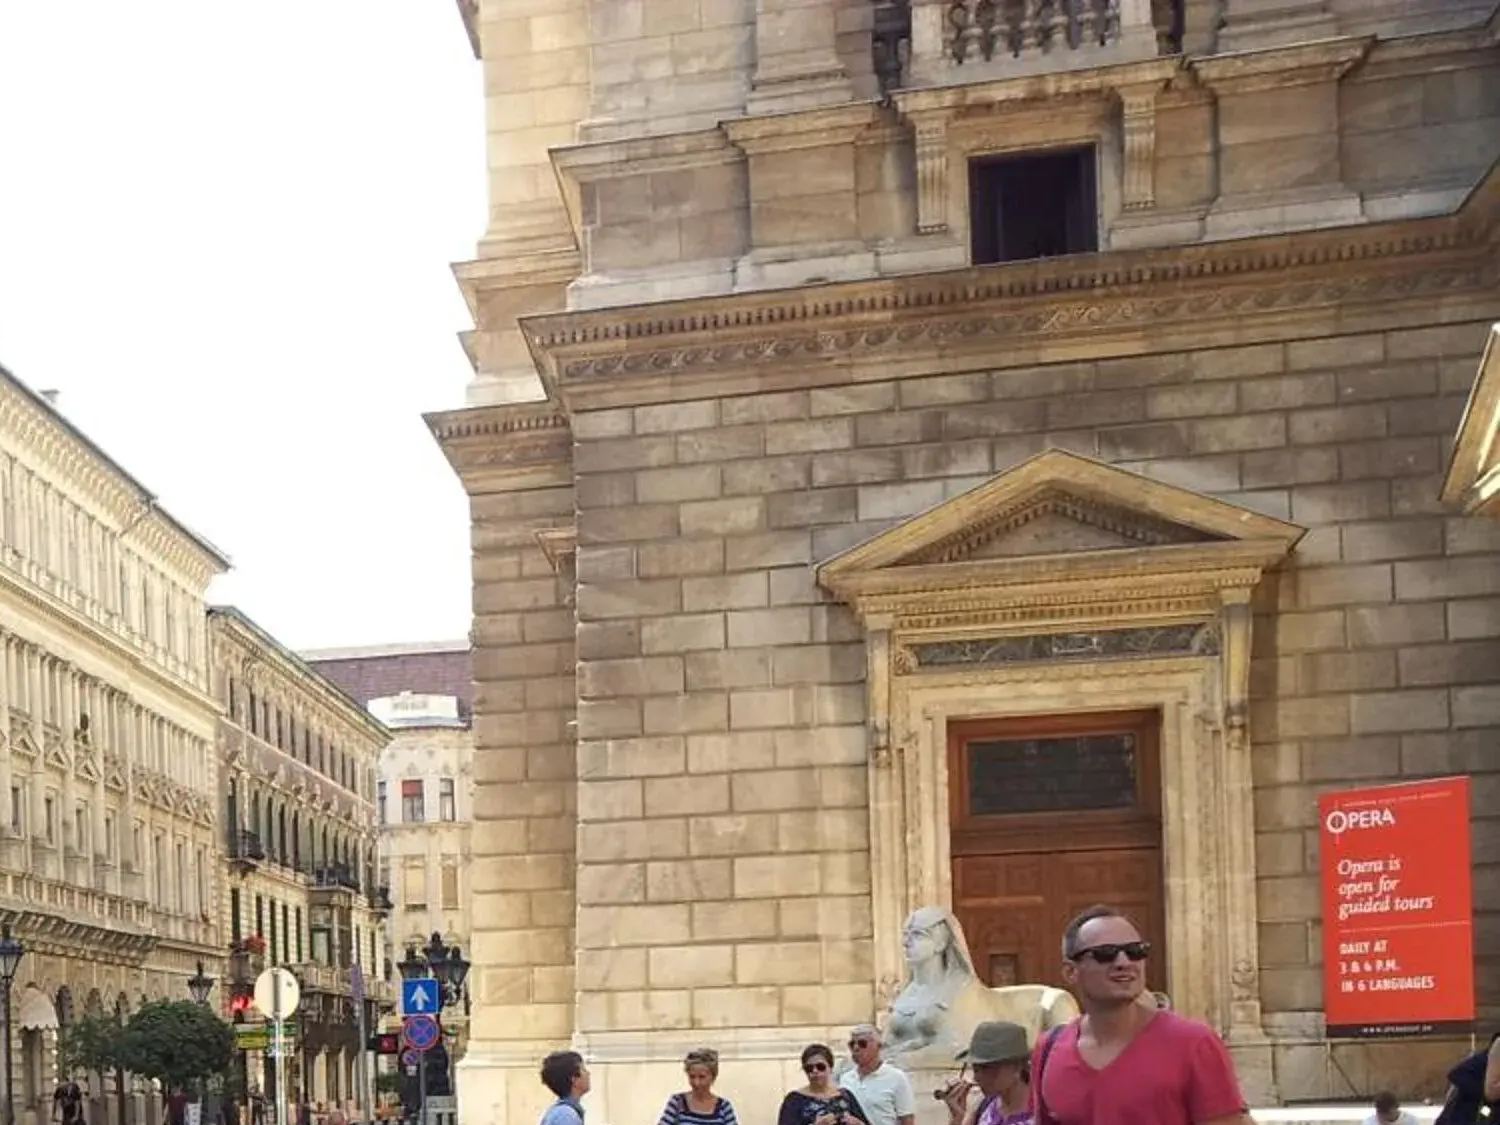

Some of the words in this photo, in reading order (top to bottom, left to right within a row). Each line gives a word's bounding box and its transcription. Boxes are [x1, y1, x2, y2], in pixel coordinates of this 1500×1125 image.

[1326, 807, 1395, 834] OPERA
[1337, 859, 1383, 879] Opera
[1388, 854, 1401, 871] is
[1338, 881, 1373, 900] open
[1374, 874, 1400, 898] for
[1338, 895, 1390, 920] guided
[1394, 896, 1435, 911] tours
[1339, 941, 1370, 954] DAILY
[1373, 939, 1388, 953] AT
[1339, 961, 1348, 975] 3
[1341, 980, 1354, 993] IN
[1357, 979, 1366, 992] 6
[1369, 975, 1436, 991] LANGUAGES
